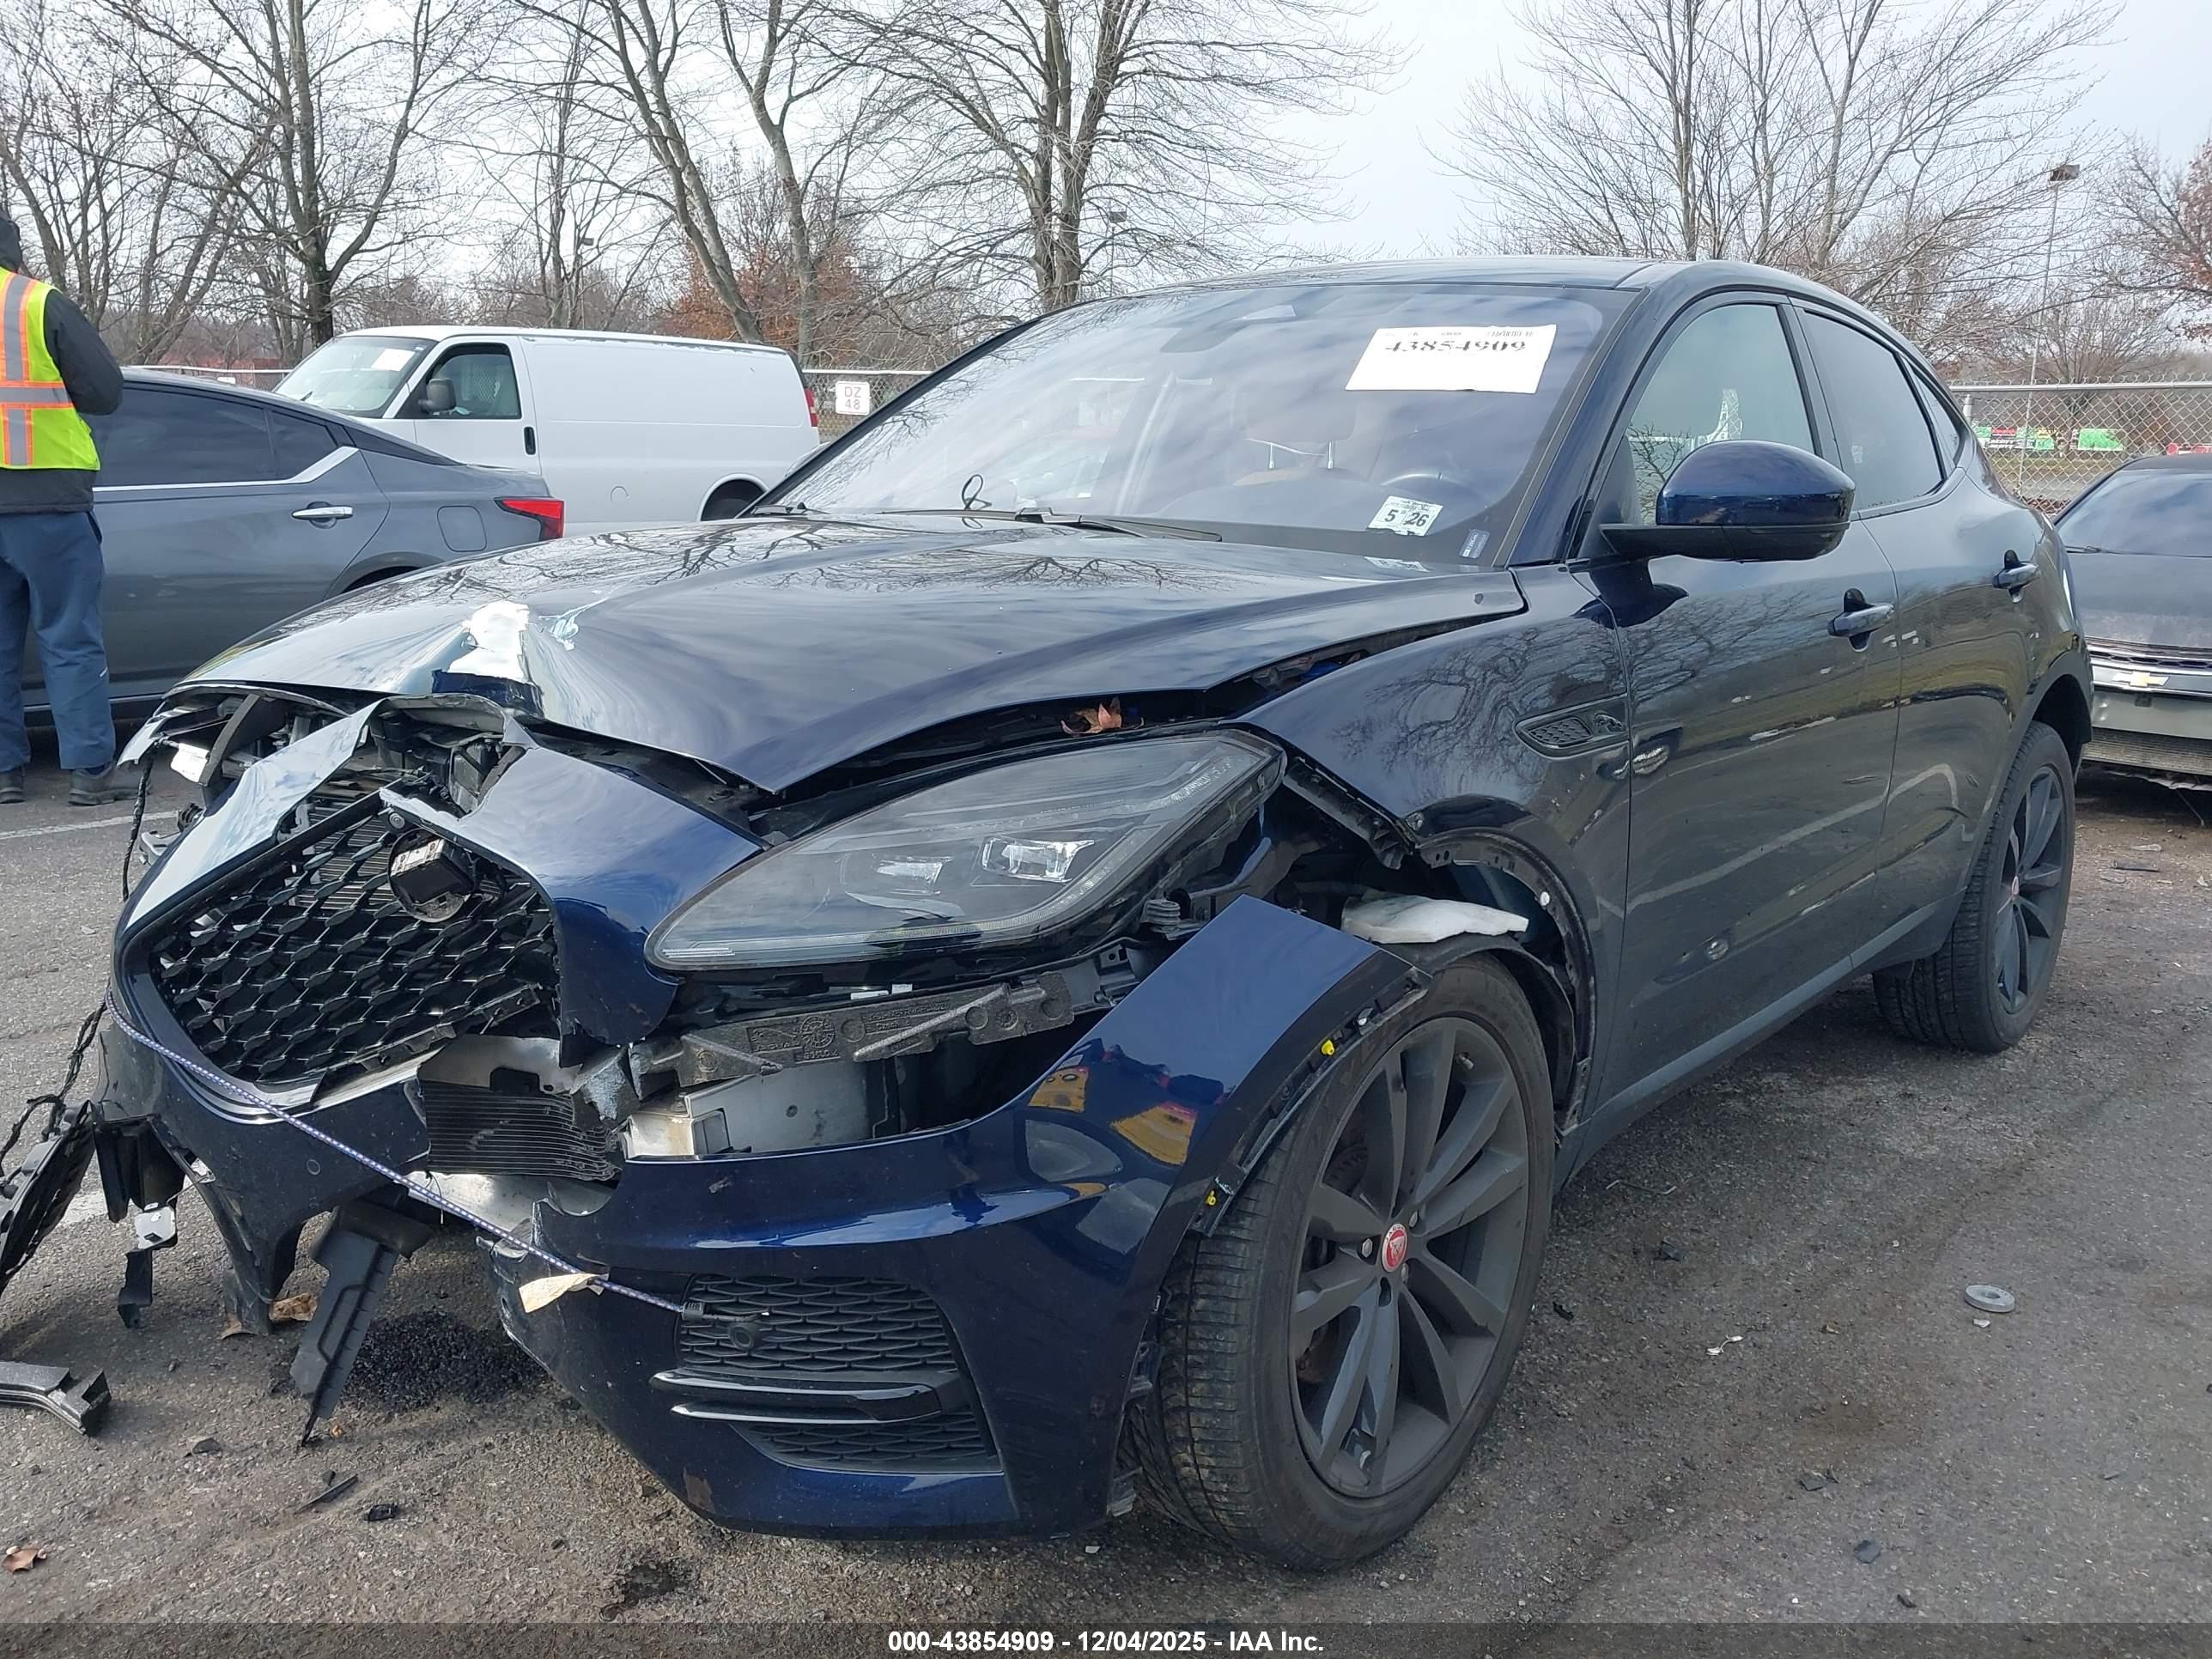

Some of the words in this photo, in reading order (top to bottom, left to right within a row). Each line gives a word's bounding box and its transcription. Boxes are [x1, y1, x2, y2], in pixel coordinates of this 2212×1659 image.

[1385, 340, 1526, 352] 43854909
[844, 386, 861, 398] DZ
[844, 398, 860, 410] 48
[1384, 509, 1399, 522] 5
[1402, 512, 1430, 526] 26
